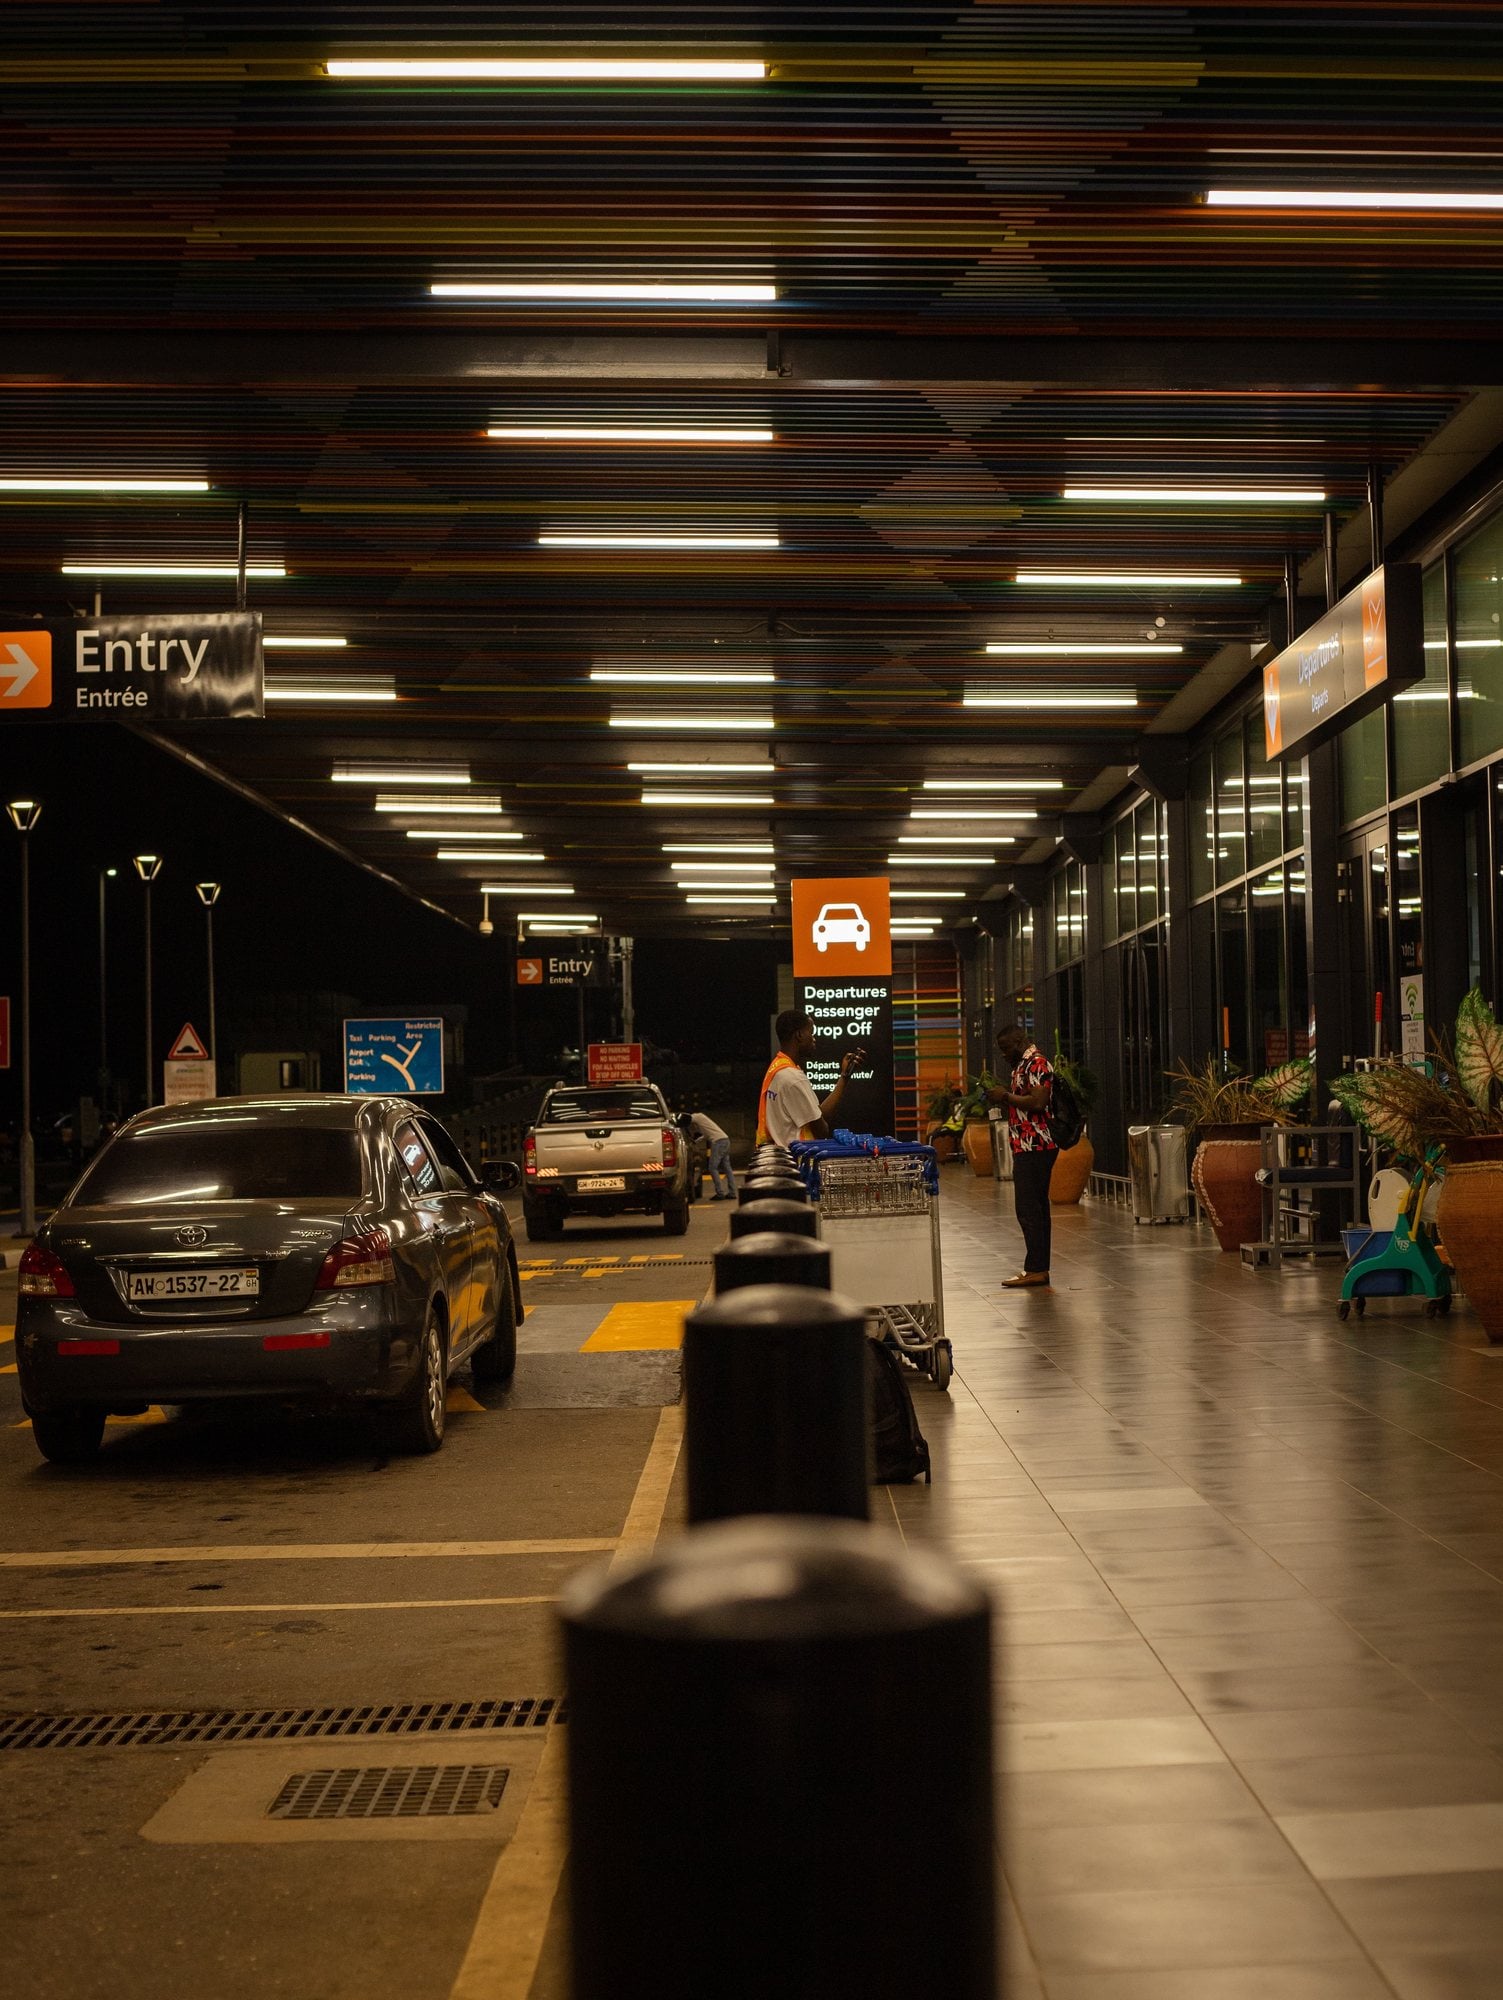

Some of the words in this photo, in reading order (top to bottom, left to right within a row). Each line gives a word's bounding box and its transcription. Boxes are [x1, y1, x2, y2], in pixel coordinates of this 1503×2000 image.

[76, 629, 209, 683] Entry
[1298, 632, 1340, 688] Departures
[77, 686, 148, 708] Entrée
[549, 957, 593, 977] Entry
[549, 976, 574, 985] Entrée
[804, 985, 887, 1002] Departures
[804, 1004, 880, 1020] Passenger
[846, 1021, 873, 1036] Off
[806, 1061, 840, 1071] Départs
[349, 1073, 376, 1081] Parking
[134, 1278, 154, 1295] AW
[165, 1274, 240, 1294] 1537-22
[246, 1279, 257, 1288] GH
